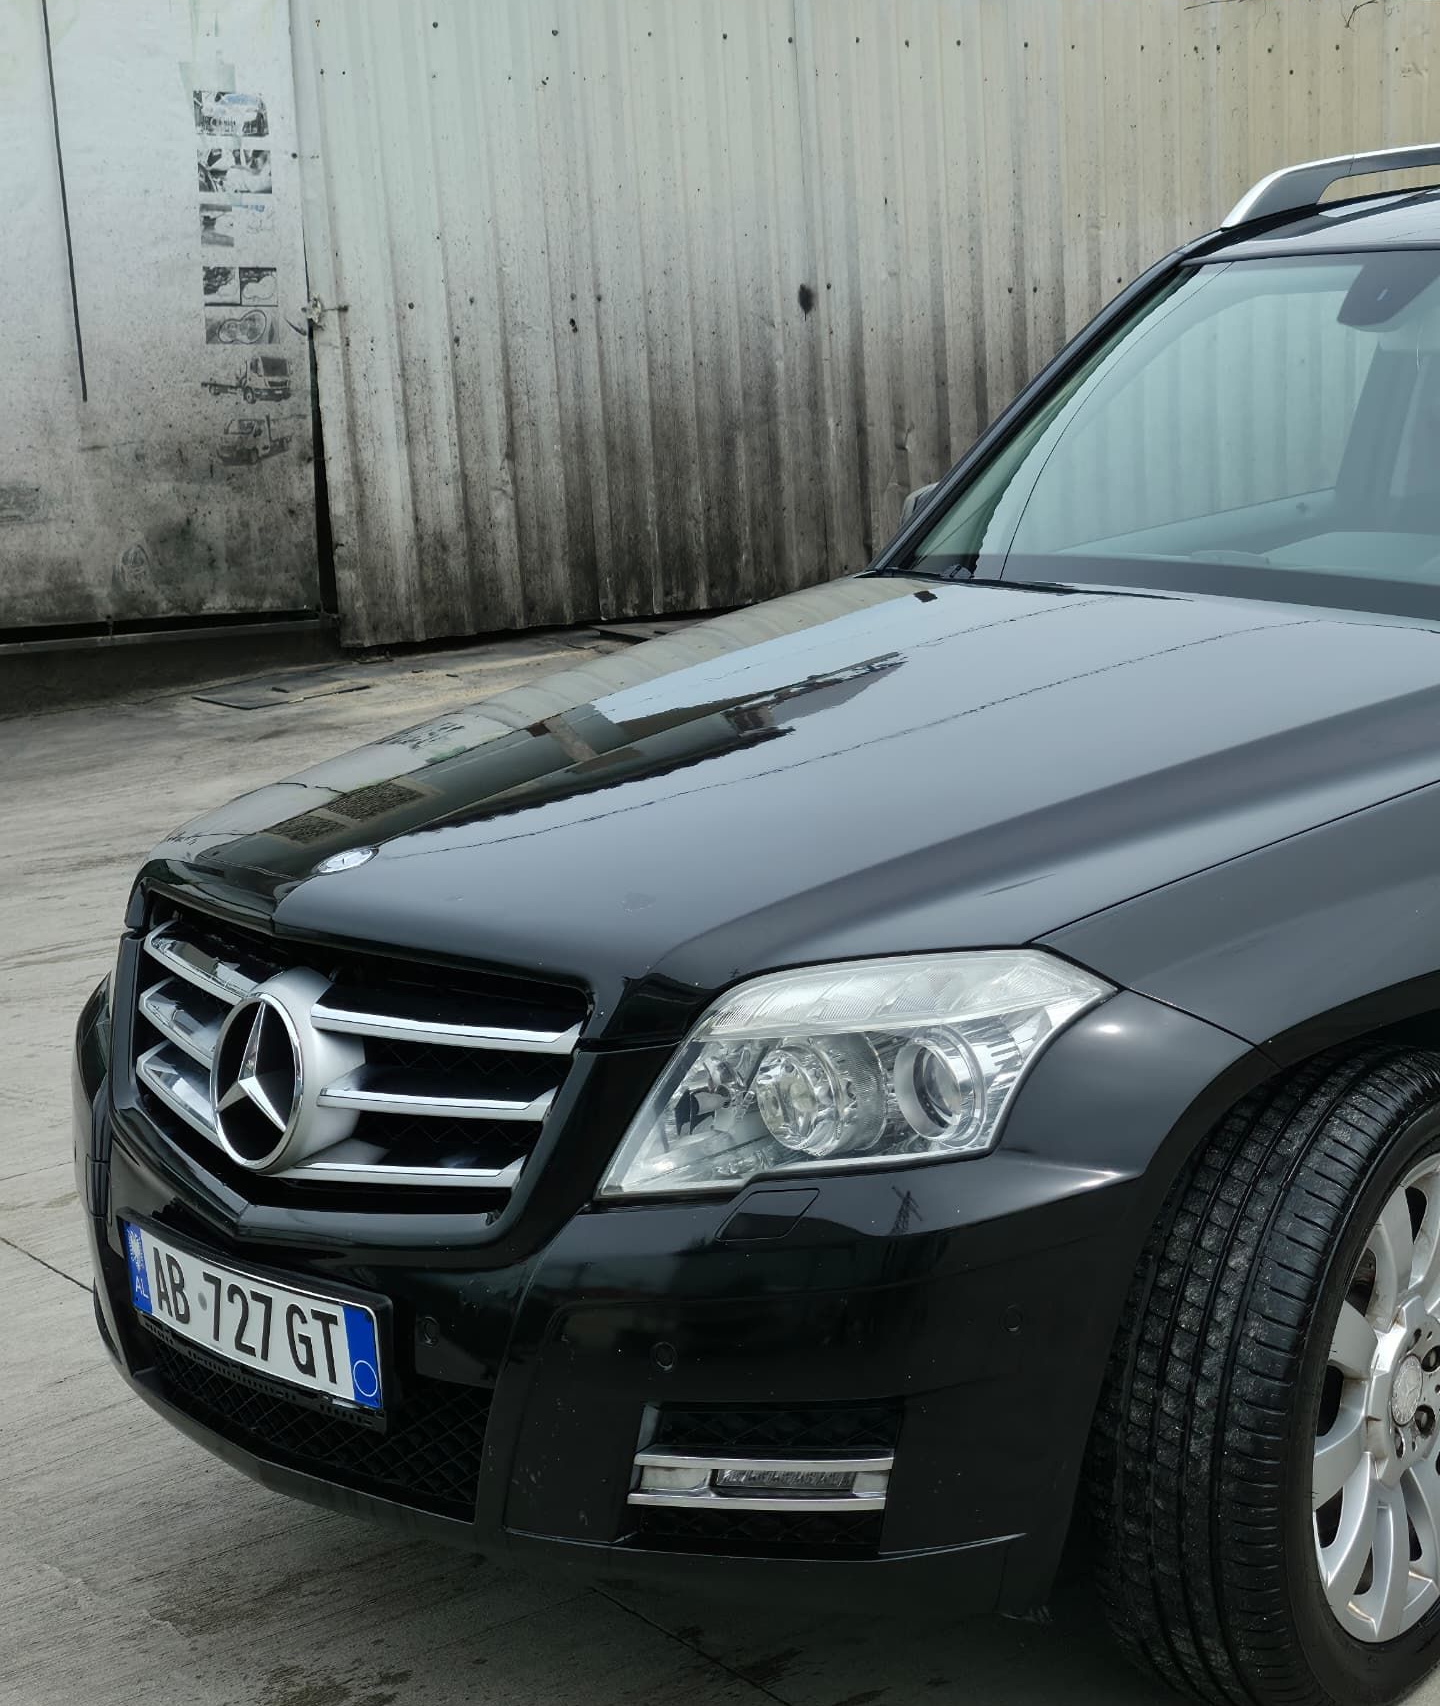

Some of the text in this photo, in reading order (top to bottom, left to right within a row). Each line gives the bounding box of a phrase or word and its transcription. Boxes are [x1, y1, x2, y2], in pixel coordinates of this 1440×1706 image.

[152, 1246, 338, 1385] AB 727 GT
